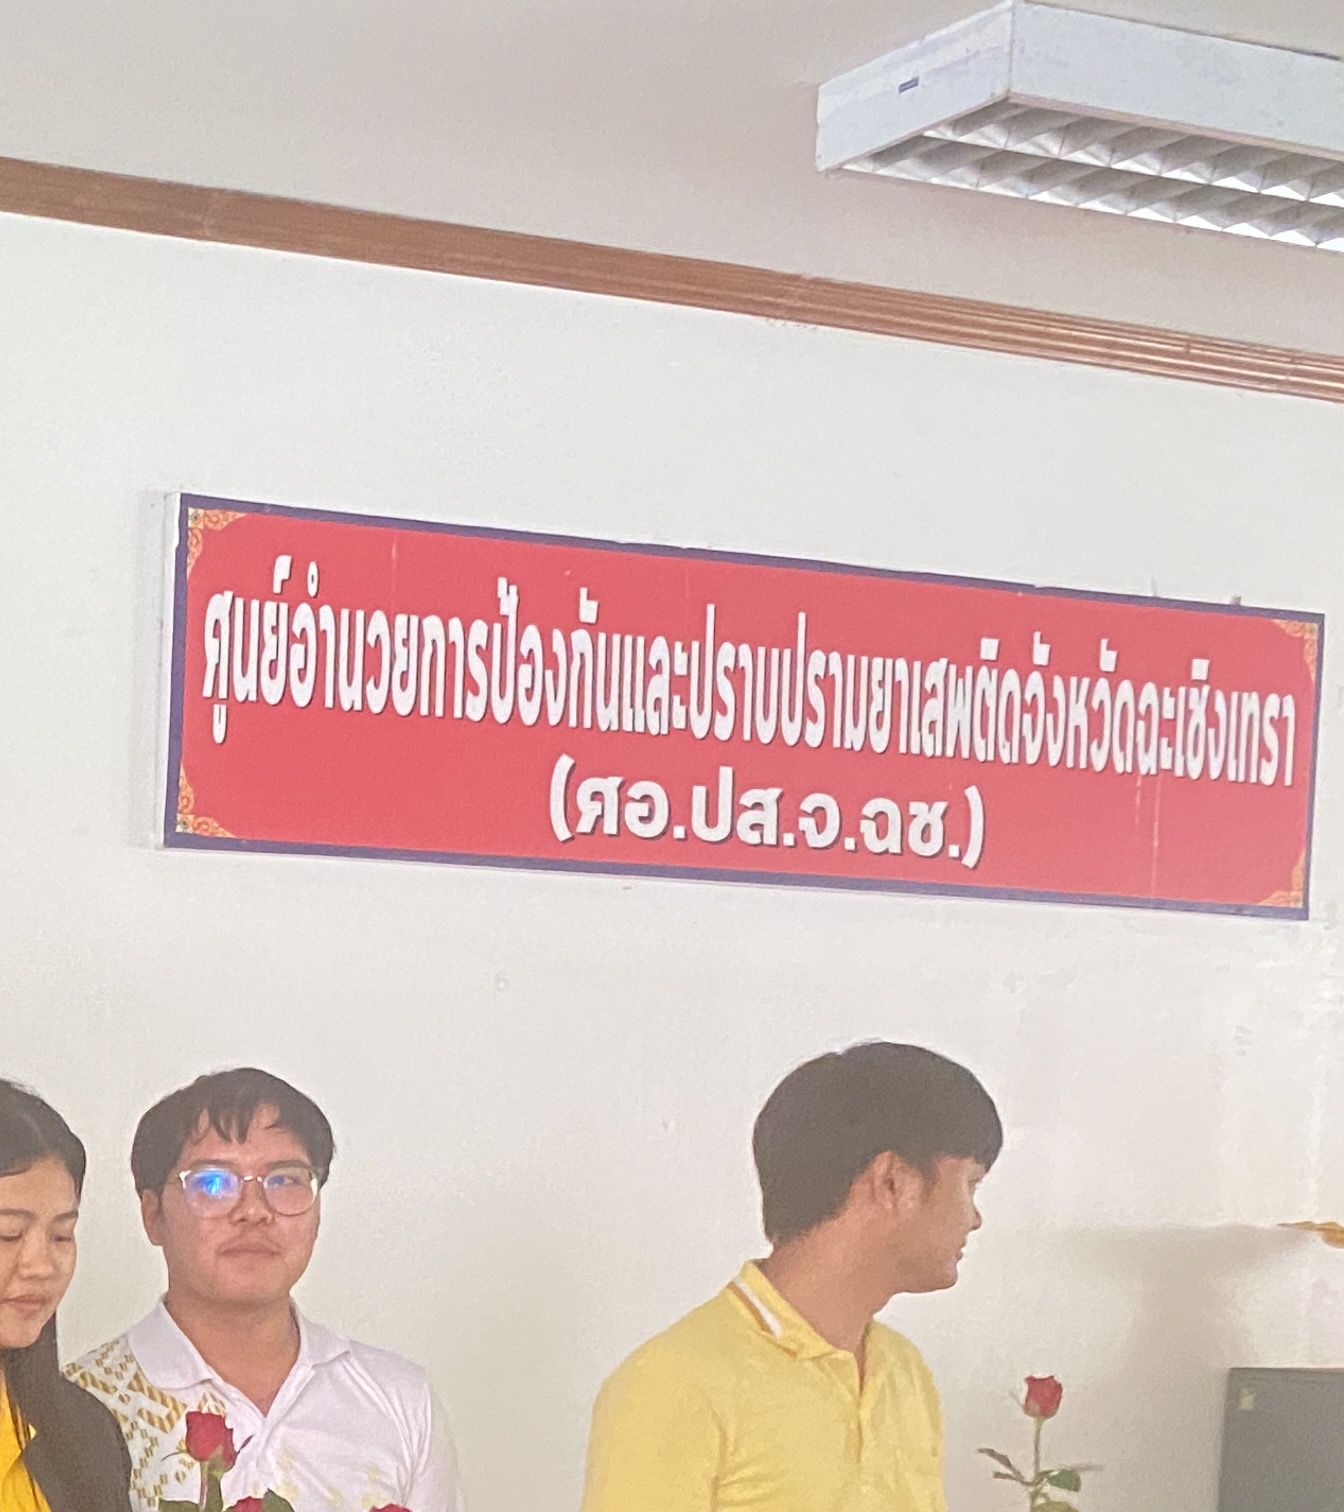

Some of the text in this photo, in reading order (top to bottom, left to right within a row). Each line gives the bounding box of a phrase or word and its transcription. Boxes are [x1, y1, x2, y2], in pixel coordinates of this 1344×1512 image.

[202, 554, 1296, 786] ศูนย์อำนวยการป้องกันและปราบปรามยาเสพติดจังหวัดฉะเชิงเทรา
[549, 754, 985, 869] (ศอ.ปส.จ.ฉช.)
